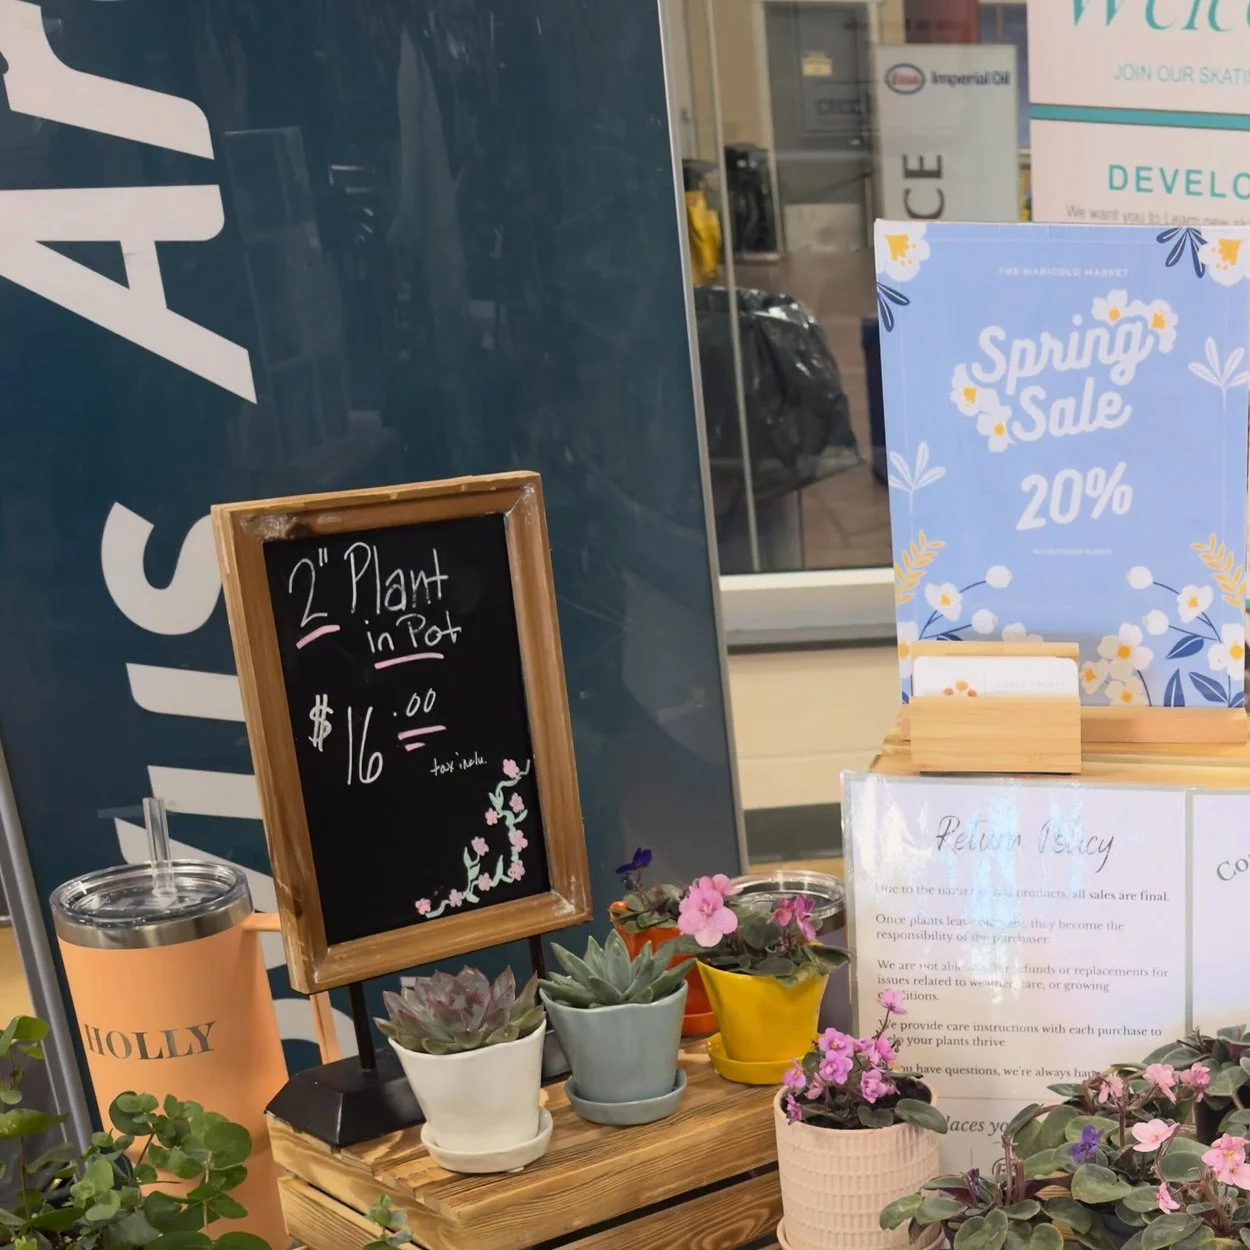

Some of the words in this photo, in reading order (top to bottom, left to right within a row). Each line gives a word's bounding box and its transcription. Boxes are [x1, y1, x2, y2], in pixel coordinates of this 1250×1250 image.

[931, 72, 988, 87] Imperial
[994, 72, 1010, 85] Oil
[1113, 62, 1152, 81] JOIN
[1157, 65, 1193, 83] OUR
[999, 267, 1018, 277] THE
[1022, 267, 1081, 277] MARIGOLD
[1085, 268, 1129, 278] MARKET
[971, 314, 1155, 395] Spring
[1011, 376, 1133, 442] Sale
[1016, 462, 1133, 530] 20%
[288, 547, 329, 628] 2"
[344, 541, 449, 615] Plant
[363, 620, 395, 655] in
[396, 611, 462, 649] Pot
[429, 754, 457, 777] tax
[1089, 889, 1116, 900] sales
[1119, 892, 1136, 901] are
[1140, 890, 1171, 902] final.
[875, 913, 906, 924] Once
[910, 916, 944, 926] plants
[1058, 919, 1103, 930] become
[1106, 920, 1125, 931] the
[876, 930, 953, 943] responsibility
[877, 959, 896, 970] We
[898, 962, 916, 970] are
[1074, 965, 1149, 977] replacements
[1152, 967, 1169, 977] for
[877, 974, 910, 985] issues
[913, 976, 951, 986] related
[955, 978, 966, 987] to
[1064, 981, 1111, 992] growing
[900, 1021, 941, 1032] provide
[946, 1023, 970, 1031] care
[973, 1023, 1039, 1033] instructions
[1042, 1024, 1066, 1034] with
[1069, 1025, 1094, 1036] each
[1097, 1026, 1147, 1037] purchase
[1151, 1028, 1162, 1036] to
[81, 1019, 219, 1062] HOLLY
[907, 1037, 933, 1047] your
[936, 1037, 969, 1047] plants
[973, 1036, 1008, 1047] thrive.
[916, 1063, 942, 1074] have
[945, 1065, 1001, 1076] questions,
[1004, 1065, 1032, 1076] we're
[1035, 1066, 1071, 1079] always
